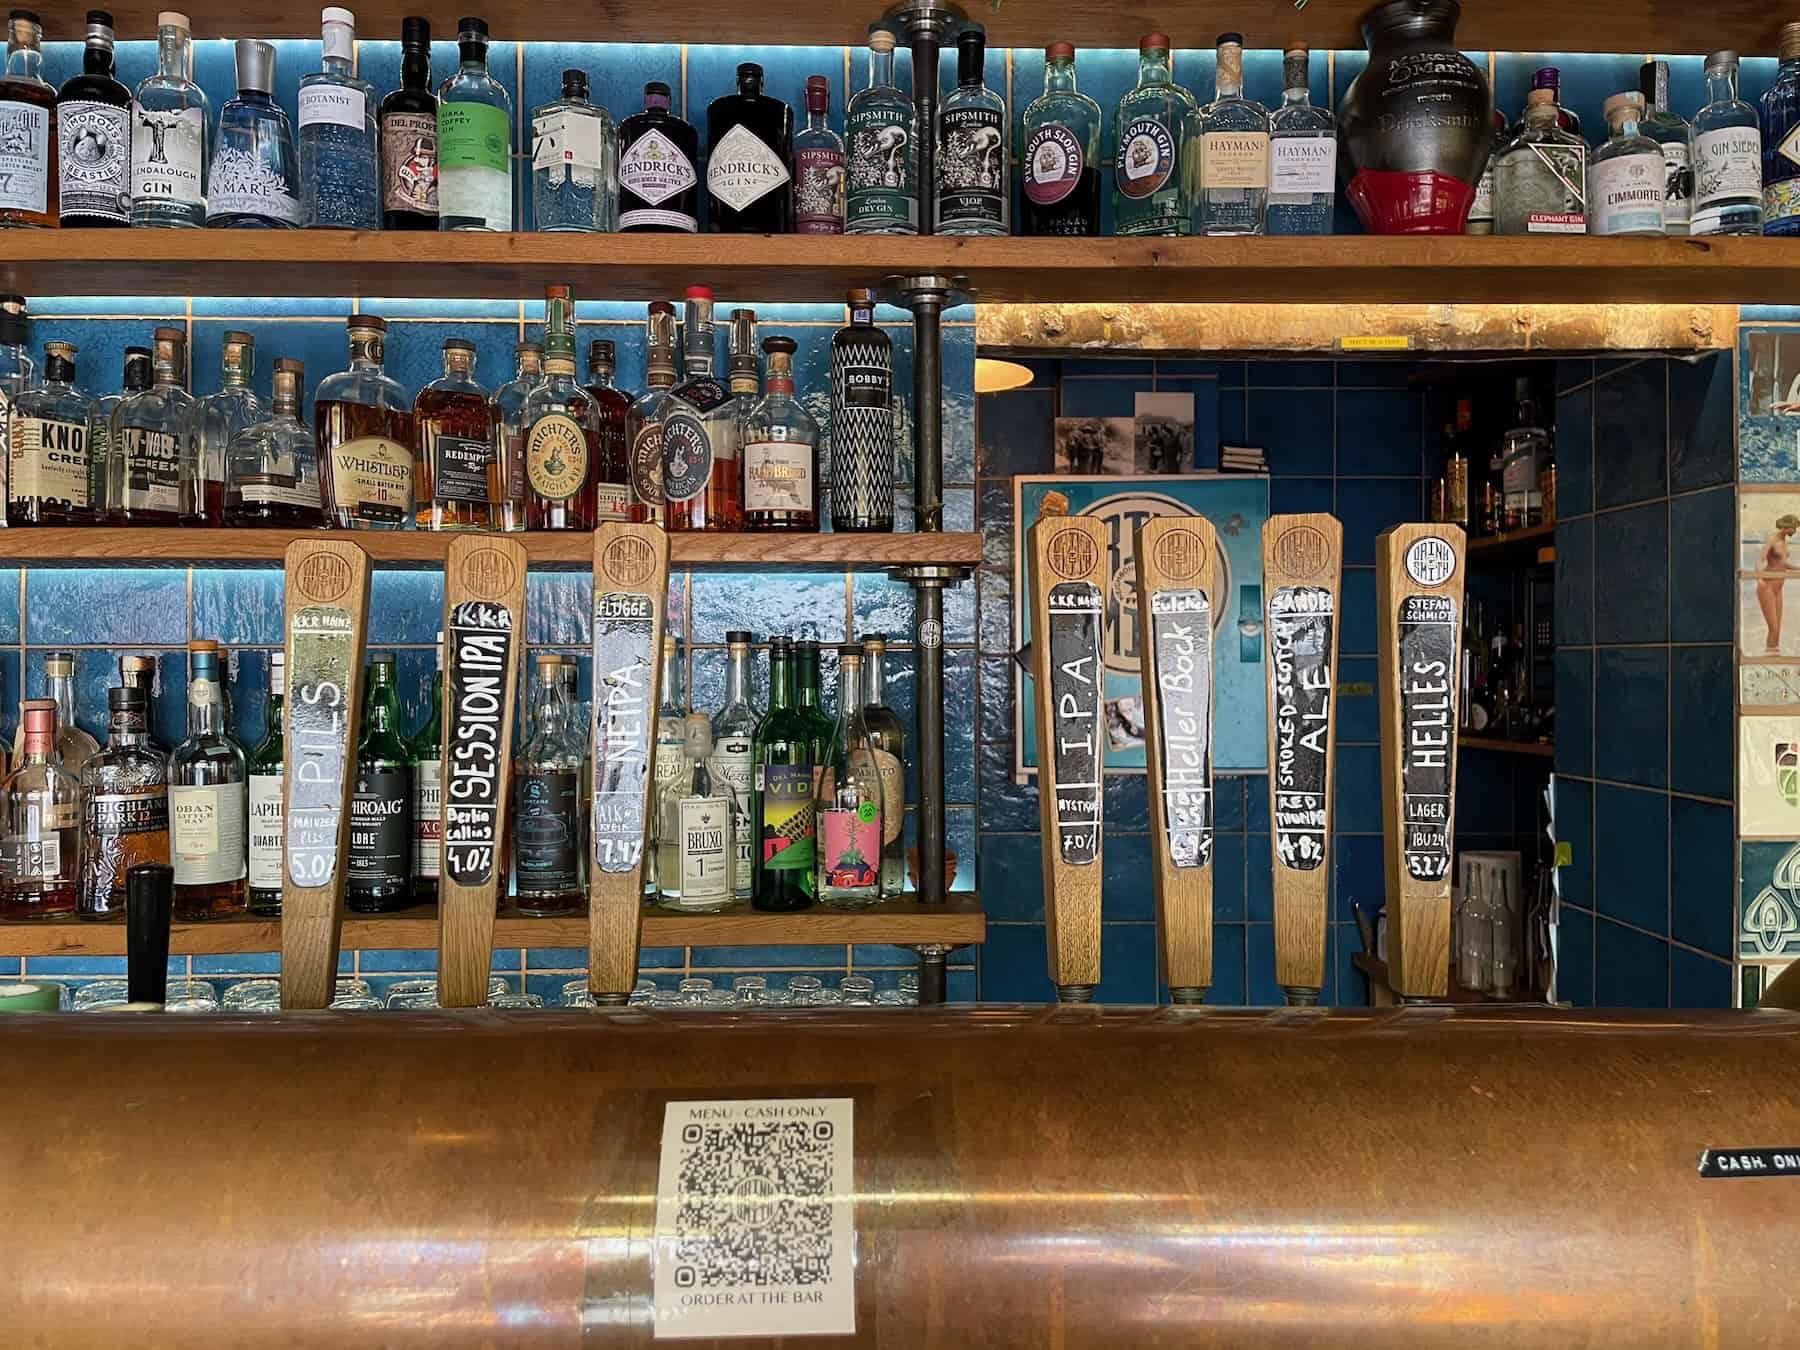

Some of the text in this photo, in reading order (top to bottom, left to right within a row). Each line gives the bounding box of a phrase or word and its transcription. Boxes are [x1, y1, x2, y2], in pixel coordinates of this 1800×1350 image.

[851, 111, 904, 122] SIPSMITH
[944, 111, 999, 122] SIPSMITH
[64, 115, 119, 139] TIMOROUS
[1117, 121, 1171, 169] PLYMOUTH GIN
[1025, 128, 1078, 184] PLYMOUTH SLOE GIN
[67, 163, 116, 180] BEASTIE
[621, 161, 690, 178] HENDRICK'S
[142, 182, 173, 194] GIN
[223, 183, 273, 196] MARE
[1530, 214, 1569, 223] ELEPHANT
[532, 424, 581, 455] MICHTER'S
[1409, 599, 1450, 610] STEFAN
[458, 634, 506, 672] IPA
[1162, 621, 1195, 693] Bock
[606, 662, 646, 763] NEIPA
[1299, 664, 1331, 753] ALE
[1411, 660, 1450, 768] HELLES
[298, 682, 343, 784] PILS
[450, 676, 502, 798] SESSION
[176, 804, 214, 813] OBAN
[1409, 803, 1445, 818] LAGER
[97, 811, 137, 824] PARK
[352, 832, 376, 845] LORE
[446, 825, 492, 841] calling
[687, 831, 722, 850] BRUXO
[1412, 832, 1445, 847] IBU 24
[447, 846, 491, 875] 4.0%
[696, 857, 705, 878] 1
[1410, 855, 1450, 877] 5.2%
[689, 1106, 828, 1120] MENU CASH ONLY
[681, 1291, 824, 1306] ORDER AT THE BAR
